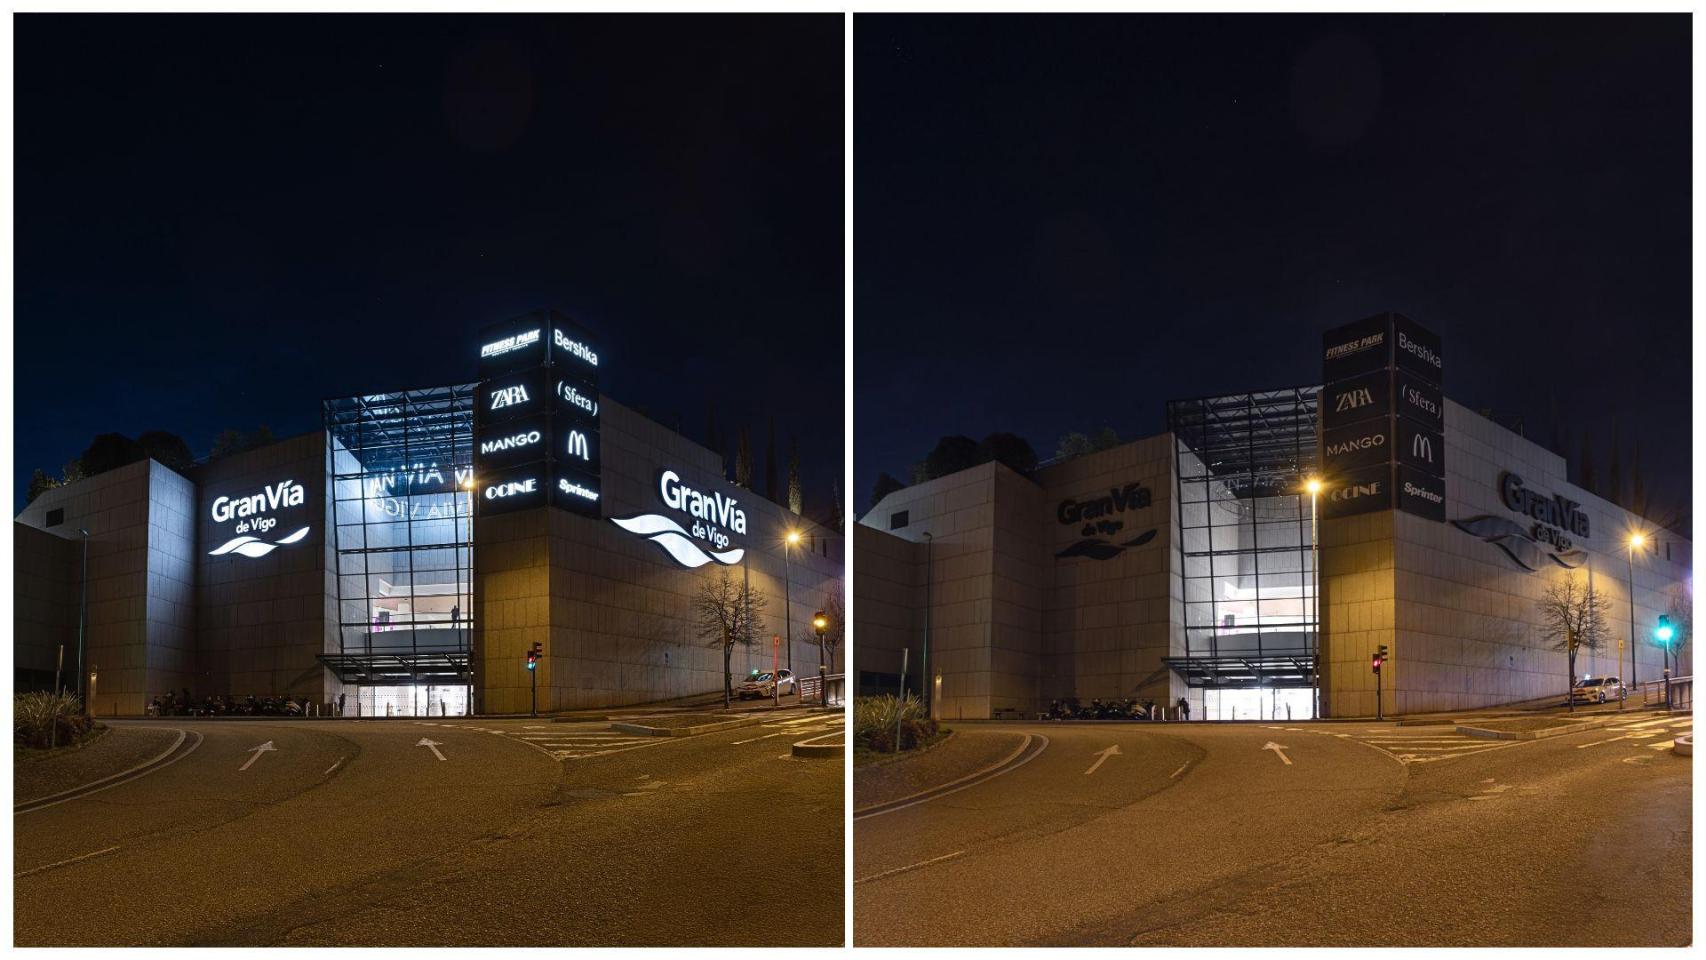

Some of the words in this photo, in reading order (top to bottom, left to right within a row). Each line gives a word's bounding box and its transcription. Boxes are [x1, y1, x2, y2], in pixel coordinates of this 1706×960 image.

[482, 337, 516, 355] FITNESS
[516, 329, 541, 344] PARK
[554, 328, 598, 366] Bershka
[1326, 340, 1360, 356] FITNESS
[1361, 332, 1385, 346] PARK
[1399, 332, 1442, 368] Bershka
[490, 384, 530, 410] ZARA
[1335, 387, 1375, 412] ZARA
[481, 431, 541, 454] MANGO
[1326, 434, 1385, 456] MANGO
[485, 479, 537, 500] OCINE
[559, 478, 598, 501] Sprinter
[1331, 481, 1382, 502] OCINE
[1404, 481, 1443, 504] Sprinter
[236, 520, 250, 534] de
[250, 517, 277, 533] Vigo
[692, 520, 705, 539] de
[706, 524, 729, 549] Vigo
[1536, 525, 1550, 542] de
[1550, 529, 1573, 551] Vigo
